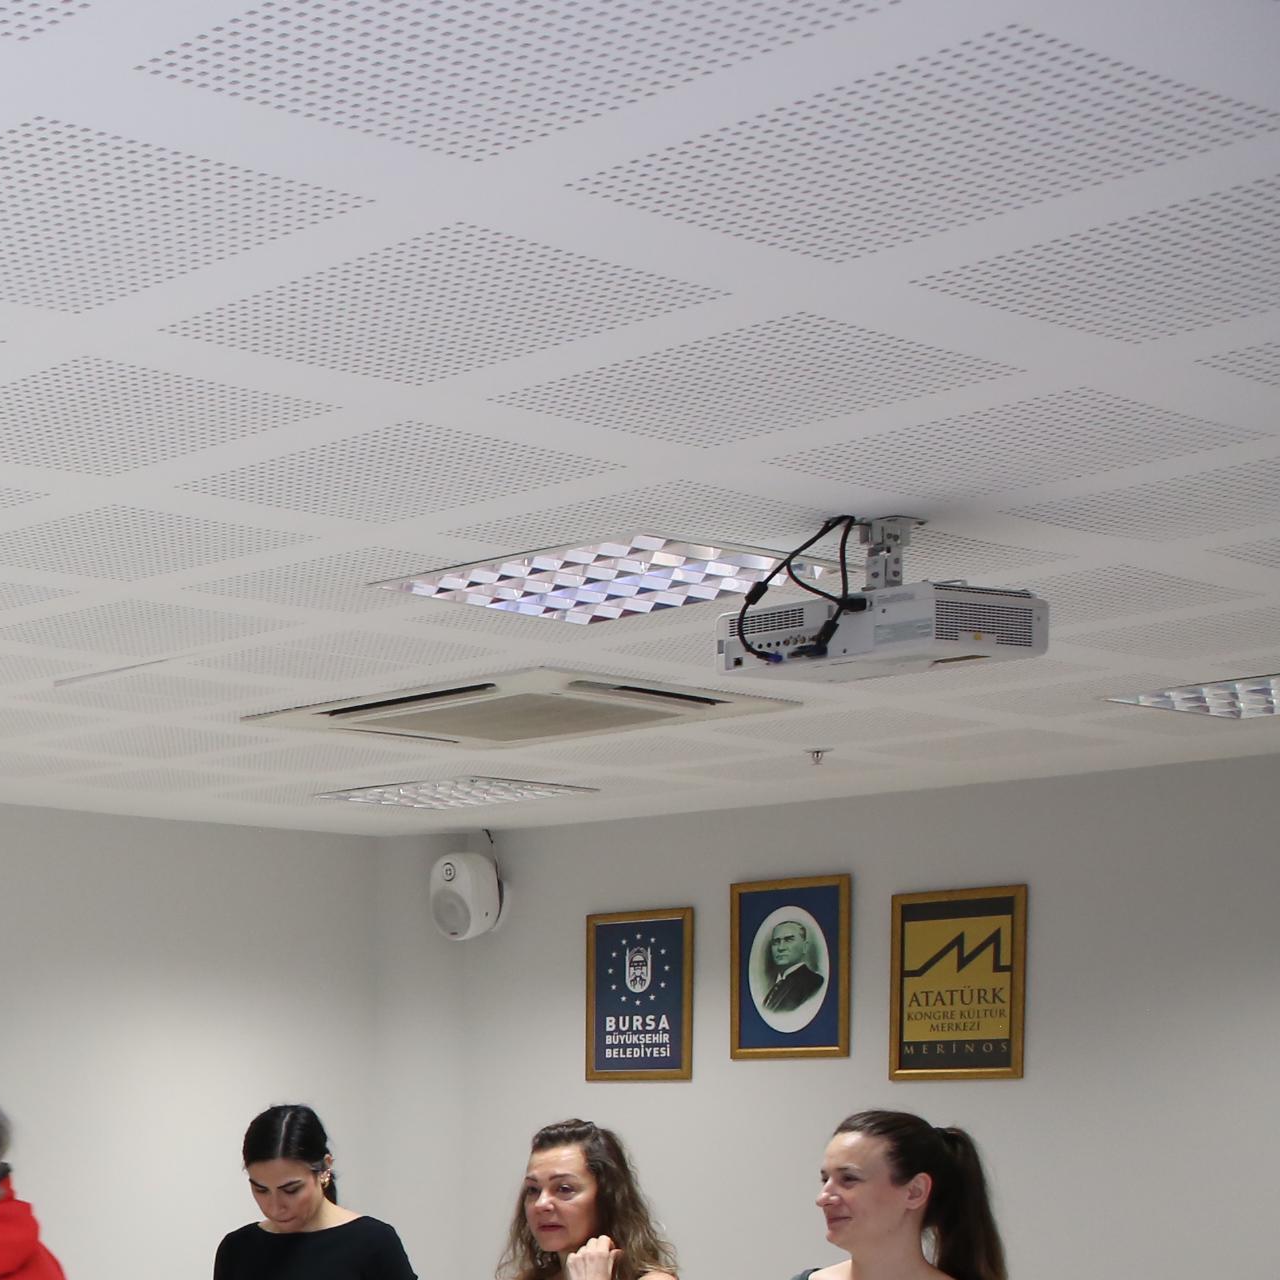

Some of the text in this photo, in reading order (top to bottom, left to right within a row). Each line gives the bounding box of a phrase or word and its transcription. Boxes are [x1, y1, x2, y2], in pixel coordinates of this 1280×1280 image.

[908, 985, 1006, 1008] ATATÜRK
[605, 1014, 670, 1031] BURSA
[907, 1010, 956, 1021] KONGRE
[605, 1044, 671, 1058] BELEDİYESİ
